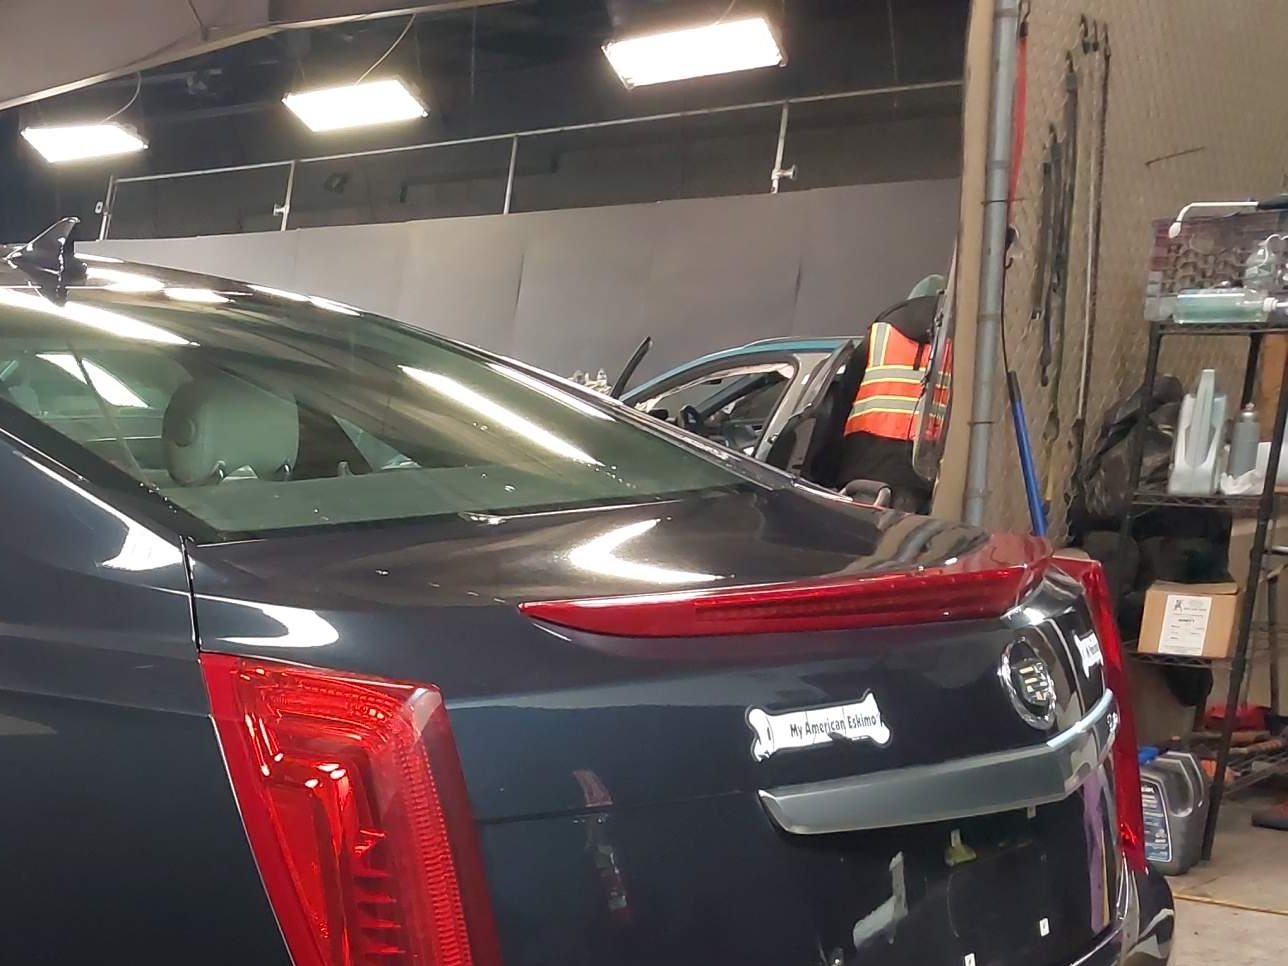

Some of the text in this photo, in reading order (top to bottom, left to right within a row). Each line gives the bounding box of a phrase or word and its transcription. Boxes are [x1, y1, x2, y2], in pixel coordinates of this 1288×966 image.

[790, 714, 877, 739] My American Eskimo
